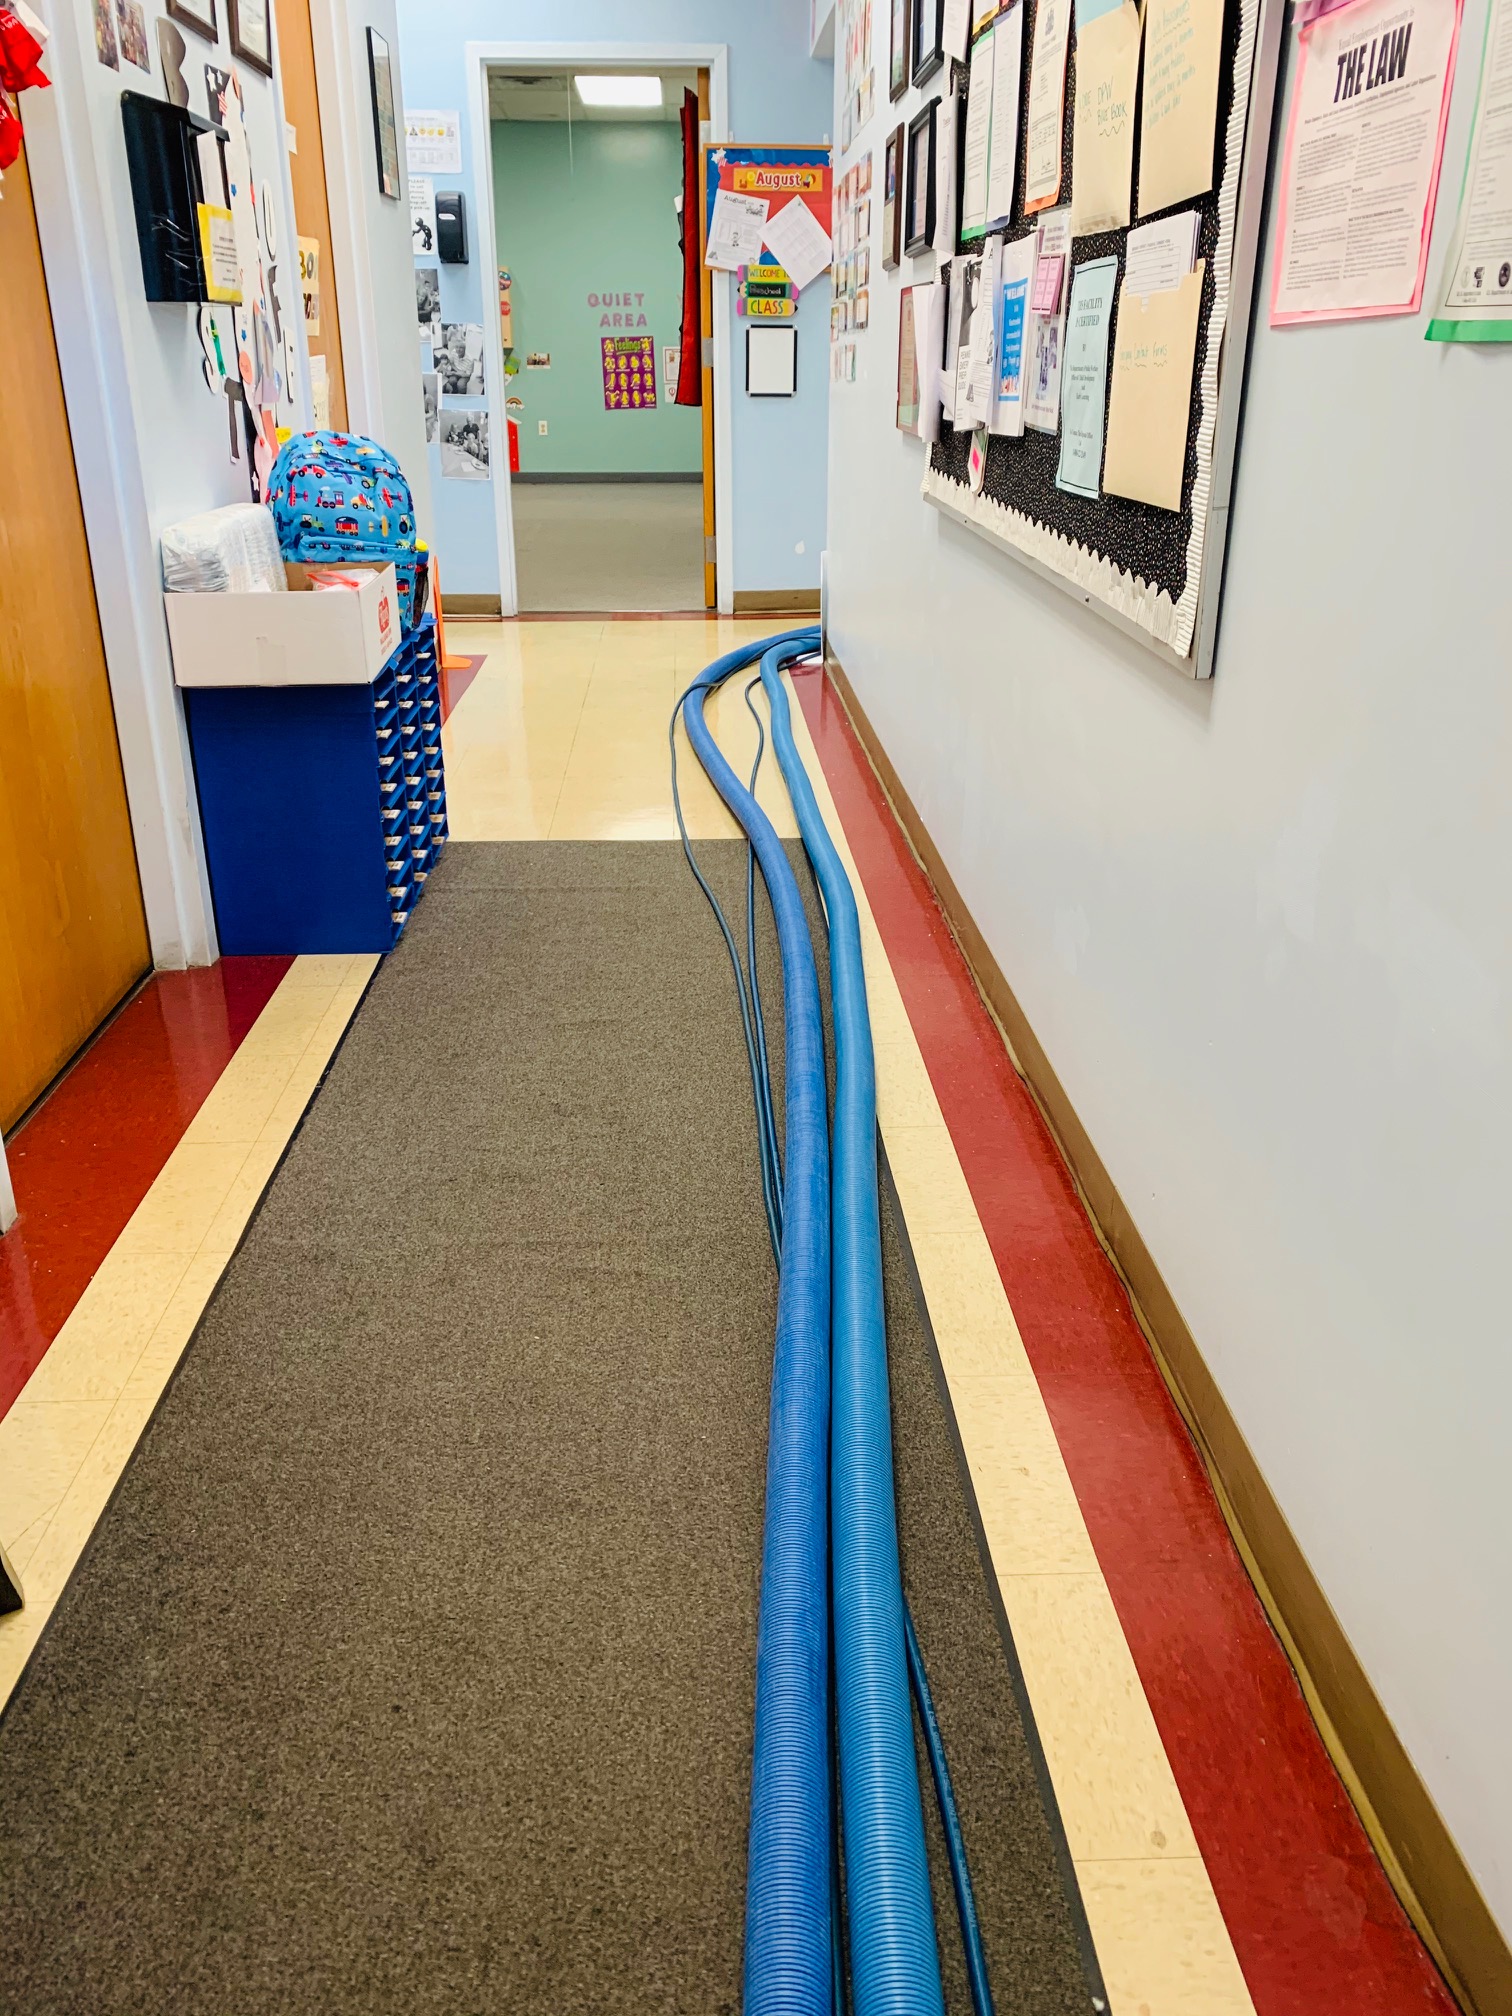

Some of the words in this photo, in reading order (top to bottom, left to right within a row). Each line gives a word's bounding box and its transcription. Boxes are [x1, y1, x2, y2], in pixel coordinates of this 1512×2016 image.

[1333, 43, 1368, 103] THE
[1366, 22, 1413, 91] LAW
[756, 171, 802, 190] August
[750, 269, 780, 278] WELCOME
[587, 293, 645, 308] QUIET
[750, 300, 784, 314] CLASS
[600, 313, 647, 327] AREA
[614, 337, 641, 352] Feelings
